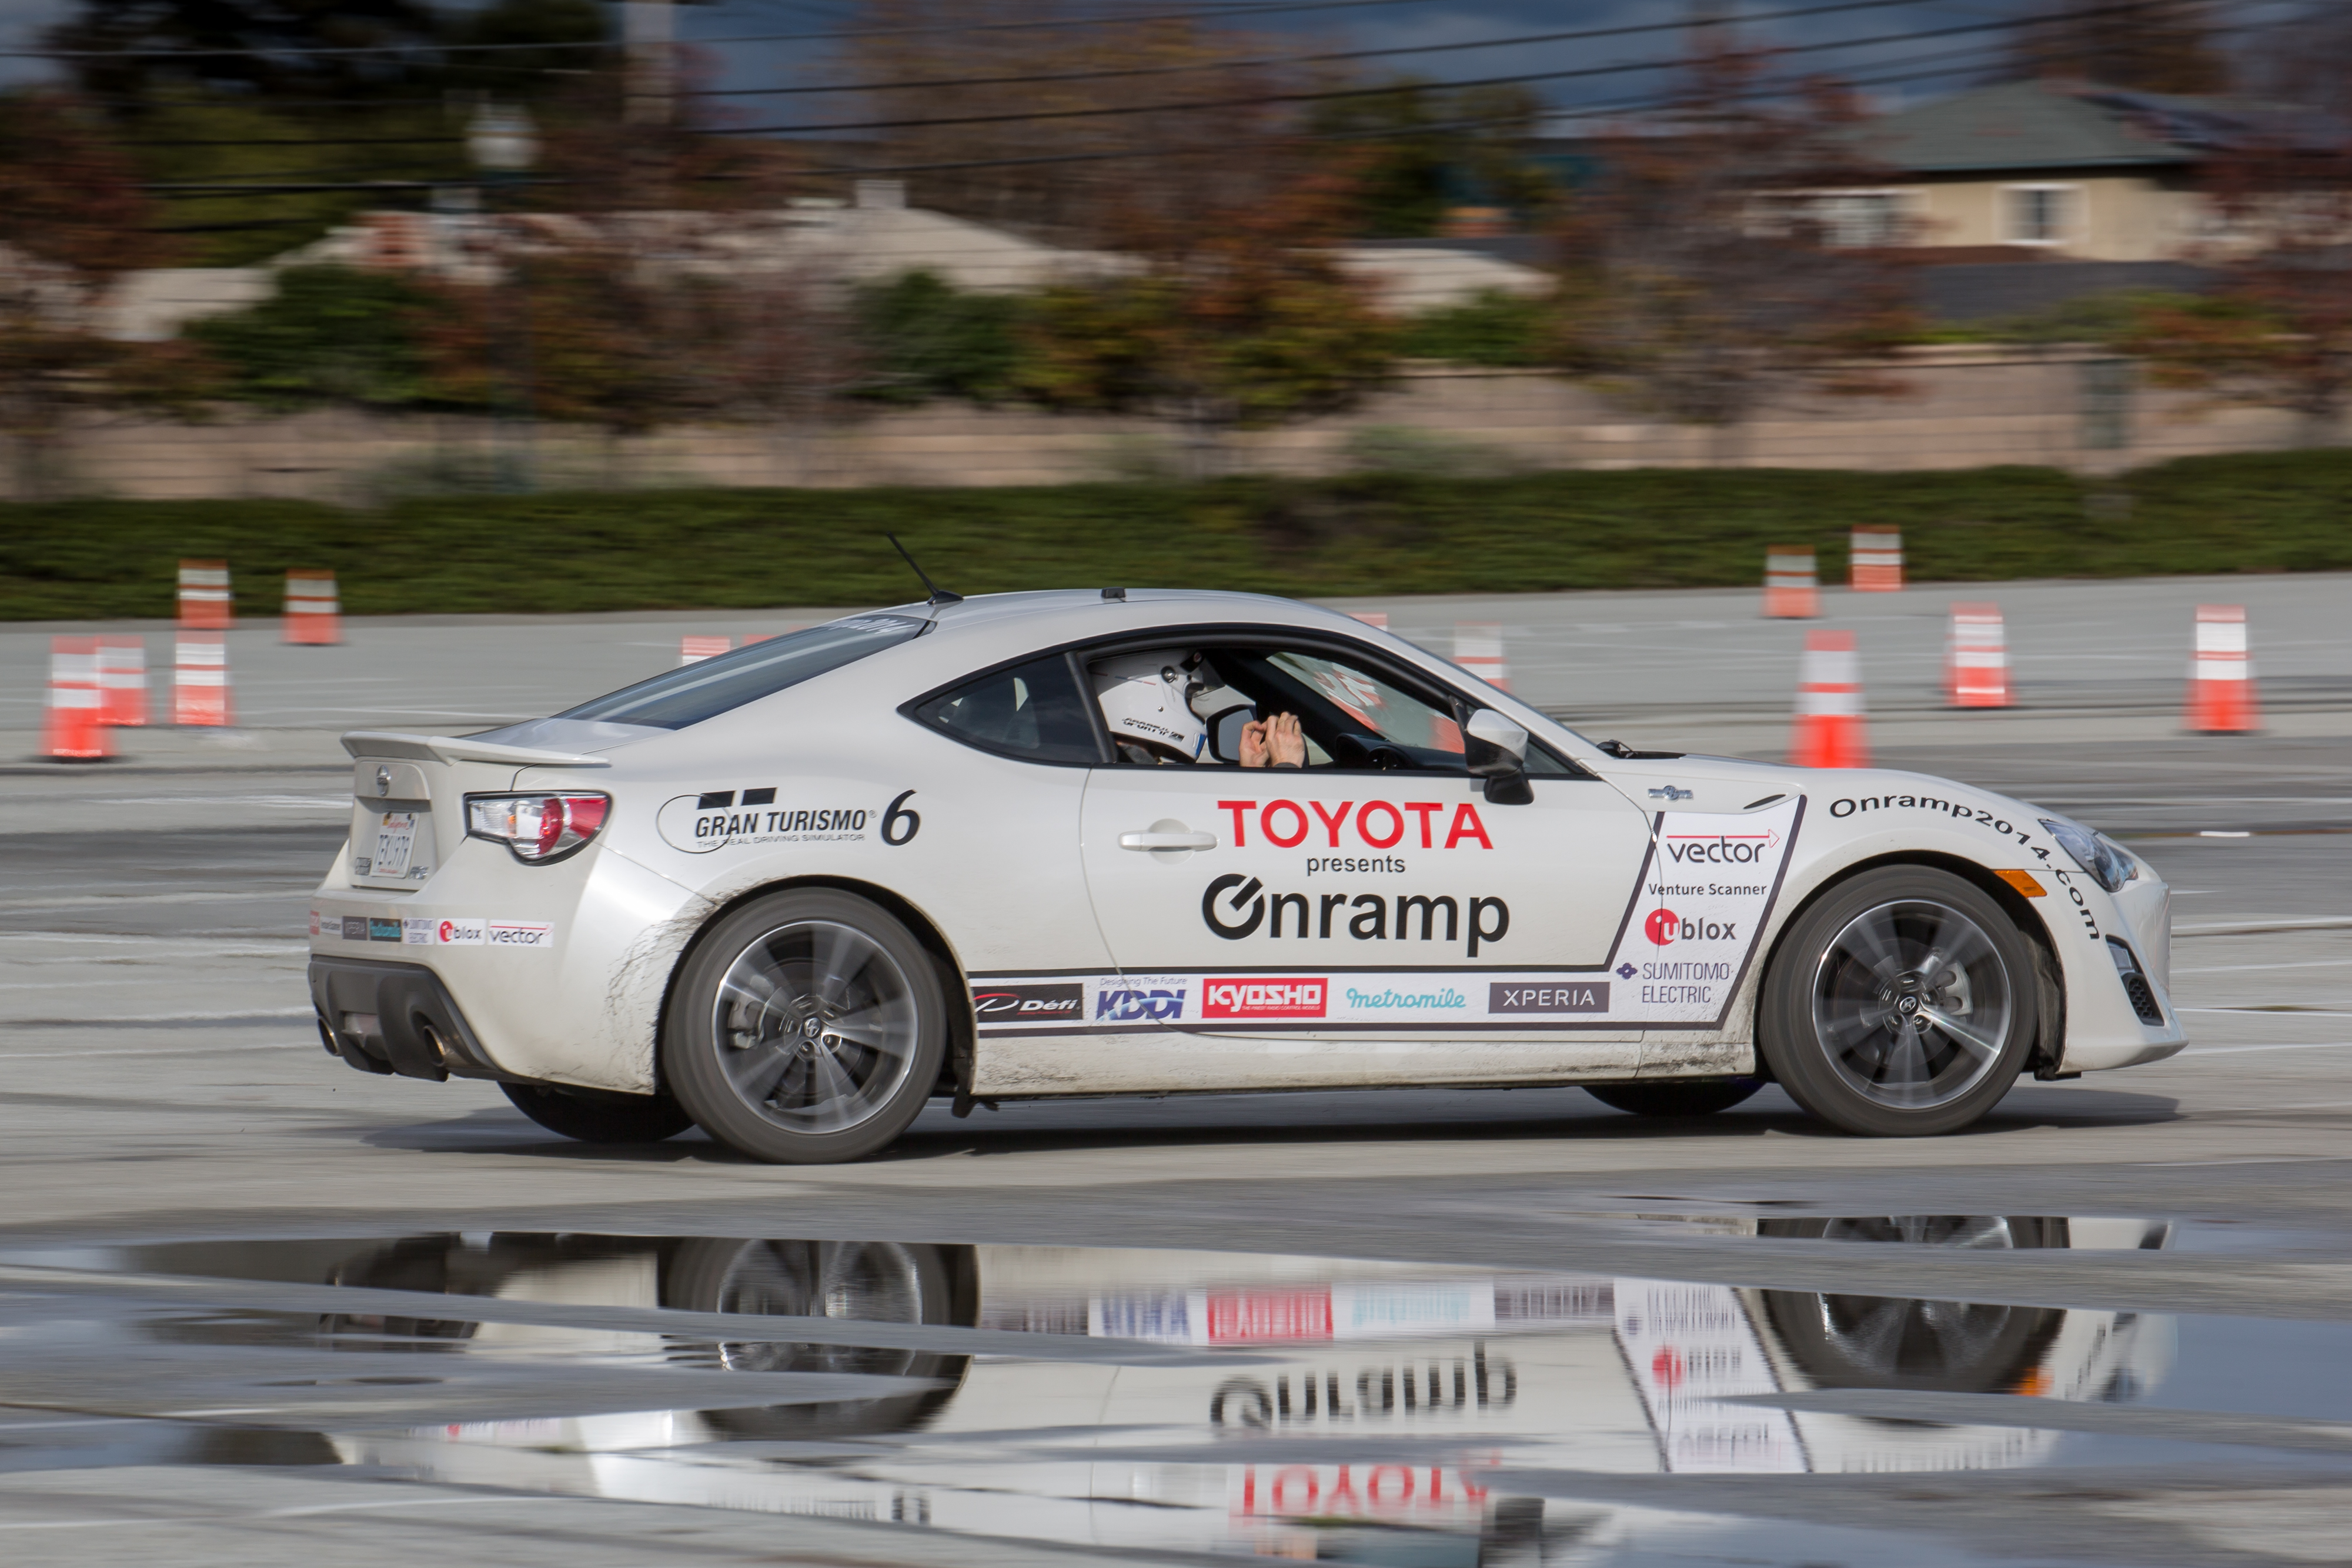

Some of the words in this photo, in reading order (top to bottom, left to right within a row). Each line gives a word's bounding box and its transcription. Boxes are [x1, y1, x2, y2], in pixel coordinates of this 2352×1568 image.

[696, 813, 760, 838] GRAN
[882, 788, 921, 846] 6
[1217, 799, 1494, 850] TOYOTA
[697, 840, 719, 848] THE
[753, 834, 799, 844] DRIVING
[1668, 835, 1765, 862] vector
[1307, 855, 1406, 876] presents
[1829, 795, 2101, 940] Onramp2014.com
[1649, 883, 1704, 895] Venture
[1708, 883, 1768, 895] Scanner
[1202, 873, 1511, 958] Onramp
[489, 927, 544, 944] vector
[1143, 977, 1158, 985] The
[1160, 976, 1188, 985] Future
[1642, 962, 1730, 980] SUMITOMO
[1208, 984, 1322, 1012] KYOSHO
[1346, 988, 1466, 1008] metromile
[1503, 989, 1596, 1007] XPERIA
[1642, 985, 1711, 1004] ELECTRIC
[1095, 989, 1187, 1021] KDDI
